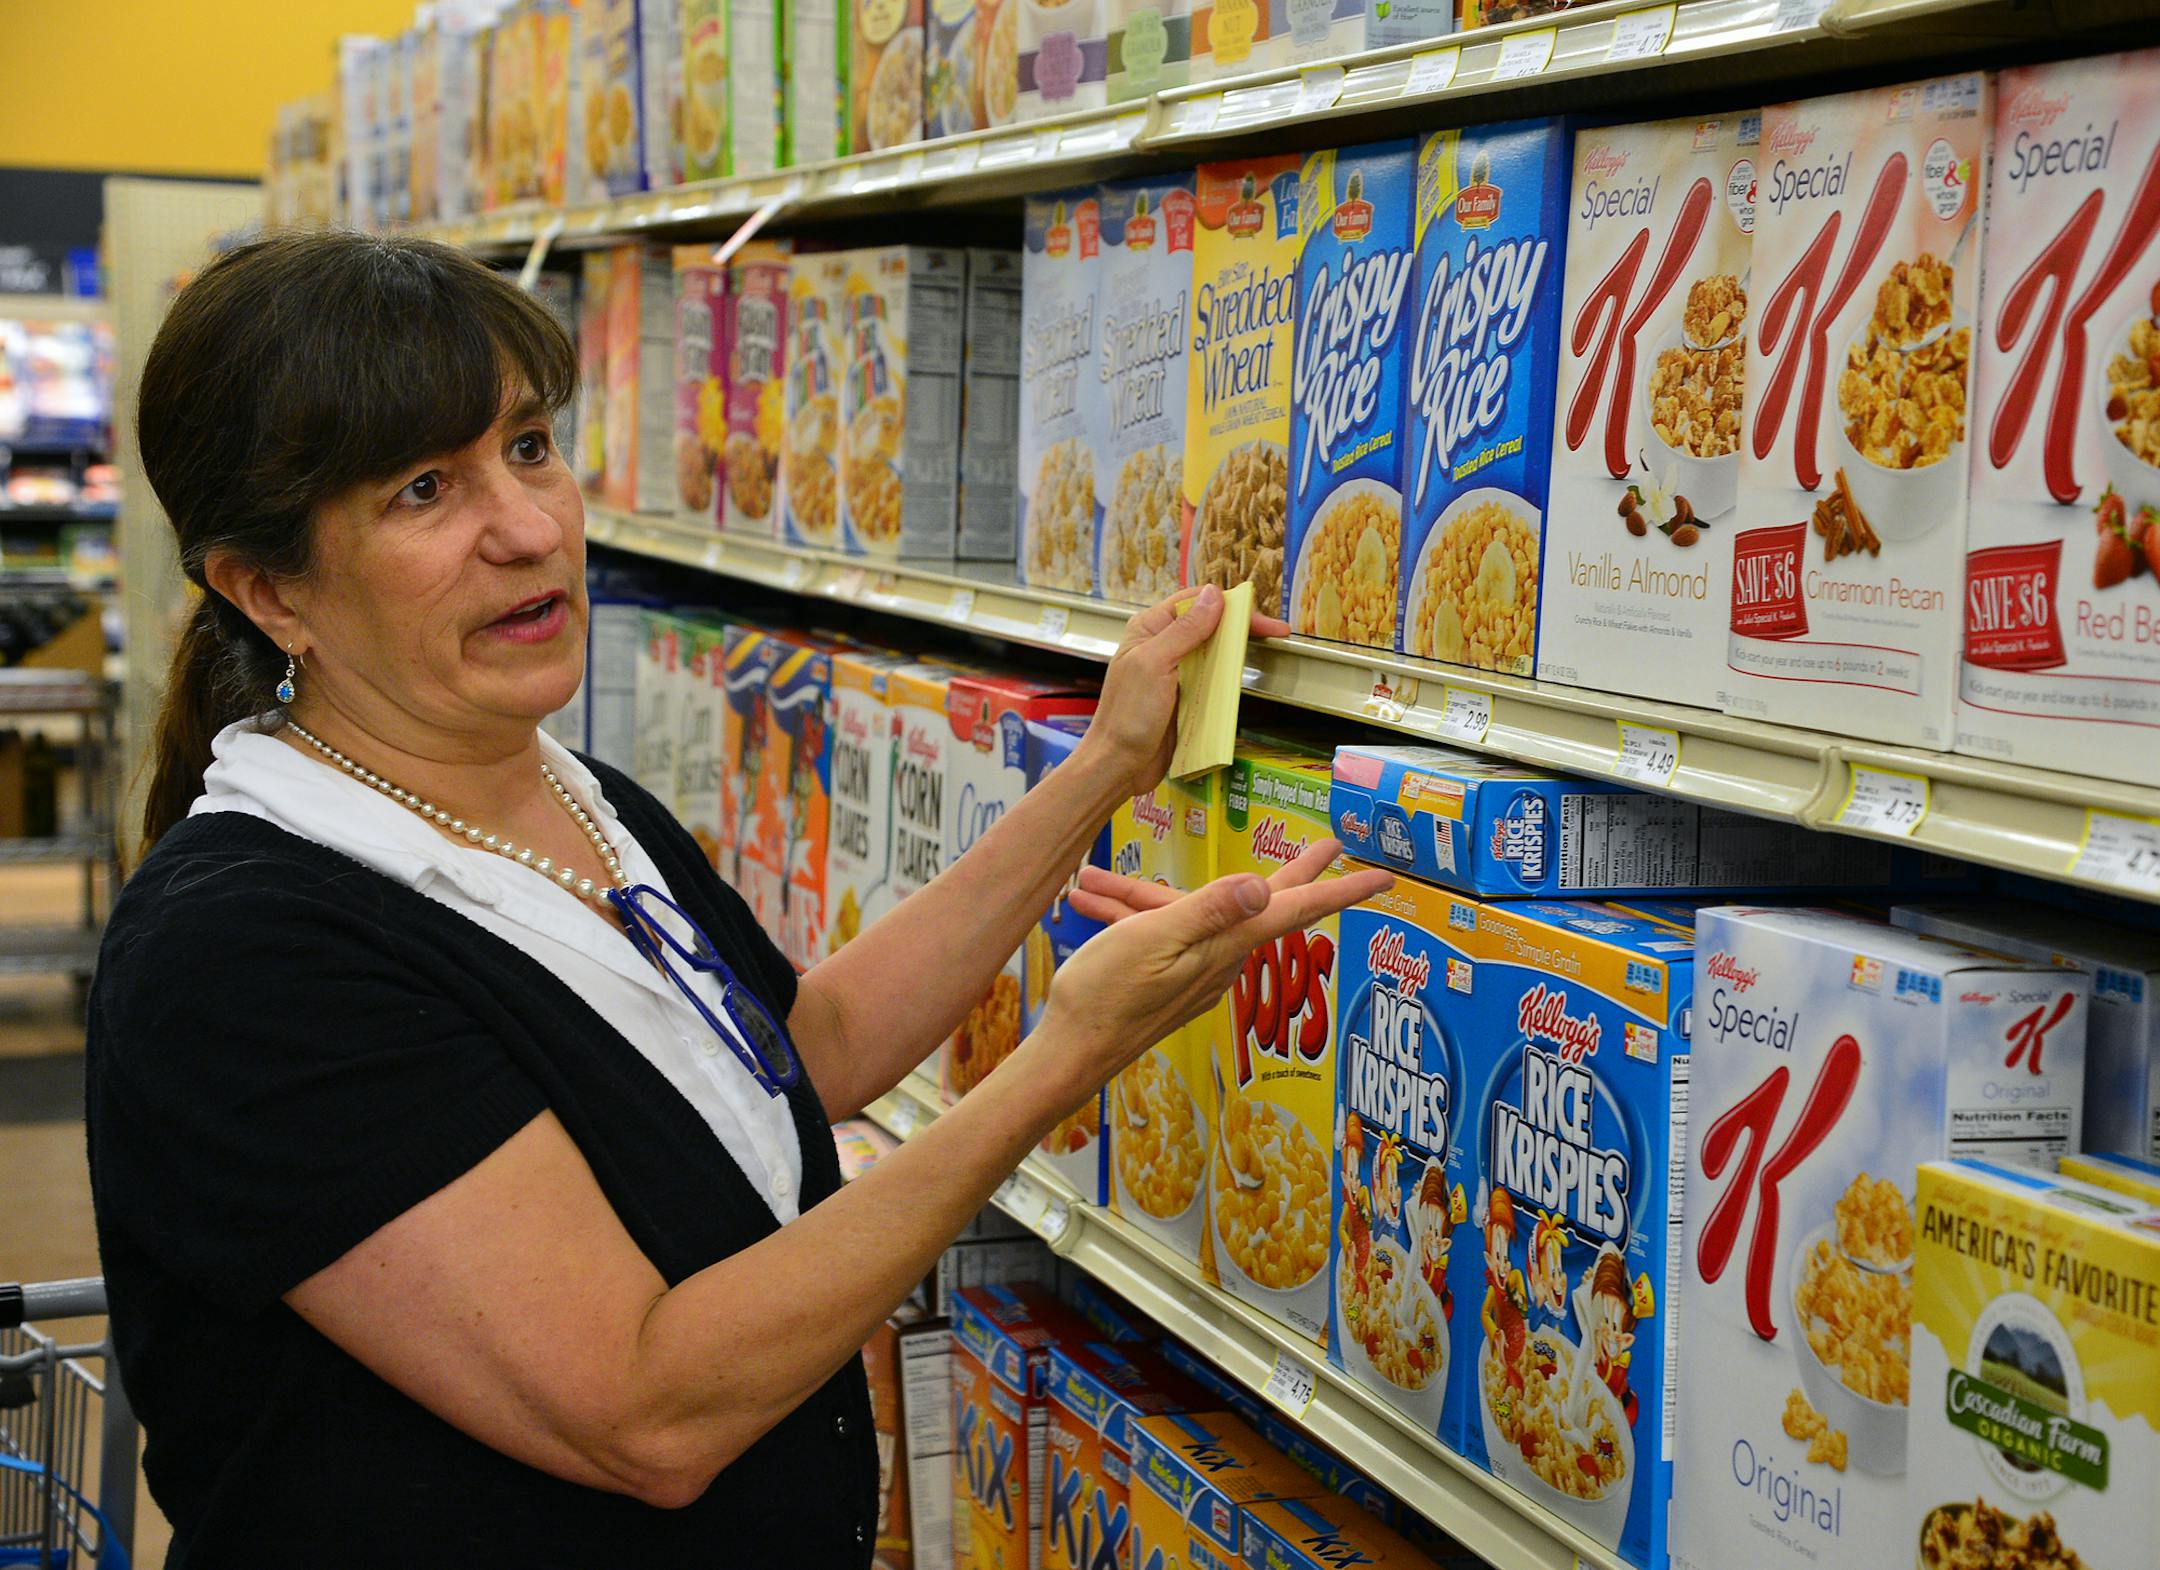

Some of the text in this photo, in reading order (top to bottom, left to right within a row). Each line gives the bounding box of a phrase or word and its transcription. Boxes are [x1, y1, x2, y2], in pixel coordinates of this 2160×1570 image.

[1638, 31, 1668, 54] 4.73
[1769, 151, 1853, 216] Special
[1943, 159, 1961, 188] &
[2009, 120, 2119, 194] Special
[1335, 208, 1370, 228] Our Family
[1456, 192, 1497, 214] Our Family
[1581, 174, 1661, 231] Special
[1194, 256, 1300, 352] Shredded
[1294, 250, 1414, 404] Crispy
[1410, 239, 1548, 406] Crispy
[1565, 176, 1713, 480] K
[1752, 151, 1909, 492] K
[1989, 137, 2160, 506] K
[1201, 331, 1274, 416] Wheat
[1299, 350, 1381, 497] Rice
[1331, 430, 1393, 474] Toasted Rice Cereal
[1415, 346, 1509, 505] Rice
[1452, 435, 1524, 482] Toasted Rice Cereal
[1568, 551, 1709, 600] Vanilla Almond
[1736, 551, 1796, 606] SAVE $6
[1806, 569, 1945, 611] Cinnamon Pecan
[1968, 572, 2049, 632] SAVE $6
[2076, 599, 2126, 642] Red
[1877, 660, 1884, 676] 2
[1463, 709, 1488, 731] 2.99
[835, 738, 871, 804] CORN
[1252, 770, 1274, 805] Simply
[1273, 776, 1299, 810] Popped
[1298, 781, 1314, 808] from
[1646, 750, 1675, 774] 4.49
[898, 760, 943, 832] CORN
[1228, 792, 1248, 812] FIBER
[1884, 798, 1922, 824] 4.75
[1252, 815, 1308, 865] Kellogg'
[1340, 809, 1371, 843] Kellogg's
[1505, 816, 1525, 862] RICE
[1520, 795, 1547, 882] KRISPIES
[1560, 796, 1570, 888] Nutrition Facts
[896, 826, 940, 886] FLAKES
[2128, 849, 2160, 878] 4.7
[1393, 895, 1417, 918] Grain
[1479, 911, 1519, 941] Goodness
[1368, 926, 1430, 998] Kellogg's
[1516, 936, 1582, 976] Simple Grain
[1707, 952, 1760, 993] Kellogg's
[1231, 928, 1336, 1088] POPS
[1519, 983, 1601, 1064] Kellogg's
[1708, 987, 1800, 1052] Special
[2008, 989, 2053, 1005] Special
[1373, 988, 1423, 1074] RICE
[2005, 991, 2075, 1076] K
[1351, 1038, 1447, 1154] KRISPIES
[1526, 1052, 1593, 1150] RICE
[1953, 1111, 2070, 1122] Nutrition Facts
[1982, 1081, 2051, 1105] Original
[1496, 1105, 1625, 1240] KRISPIES
[1697, 1033, 1862, 1342] K
[1922, 1204, 2037, 1281] AMERICA'S
[2043, 1248, 2160, 1327] FAVORITE
[1291, 1379, 1313, 1404] 4.75
[1950, 1373, 2103, 1467] Cascadian Farm
[1977, 1418, 2064, 1471] ORGANIC
[1732, 1438, 1842, 1537] Original
[1749, 1513, 1818, 1562] Toasted Rice Cereal
